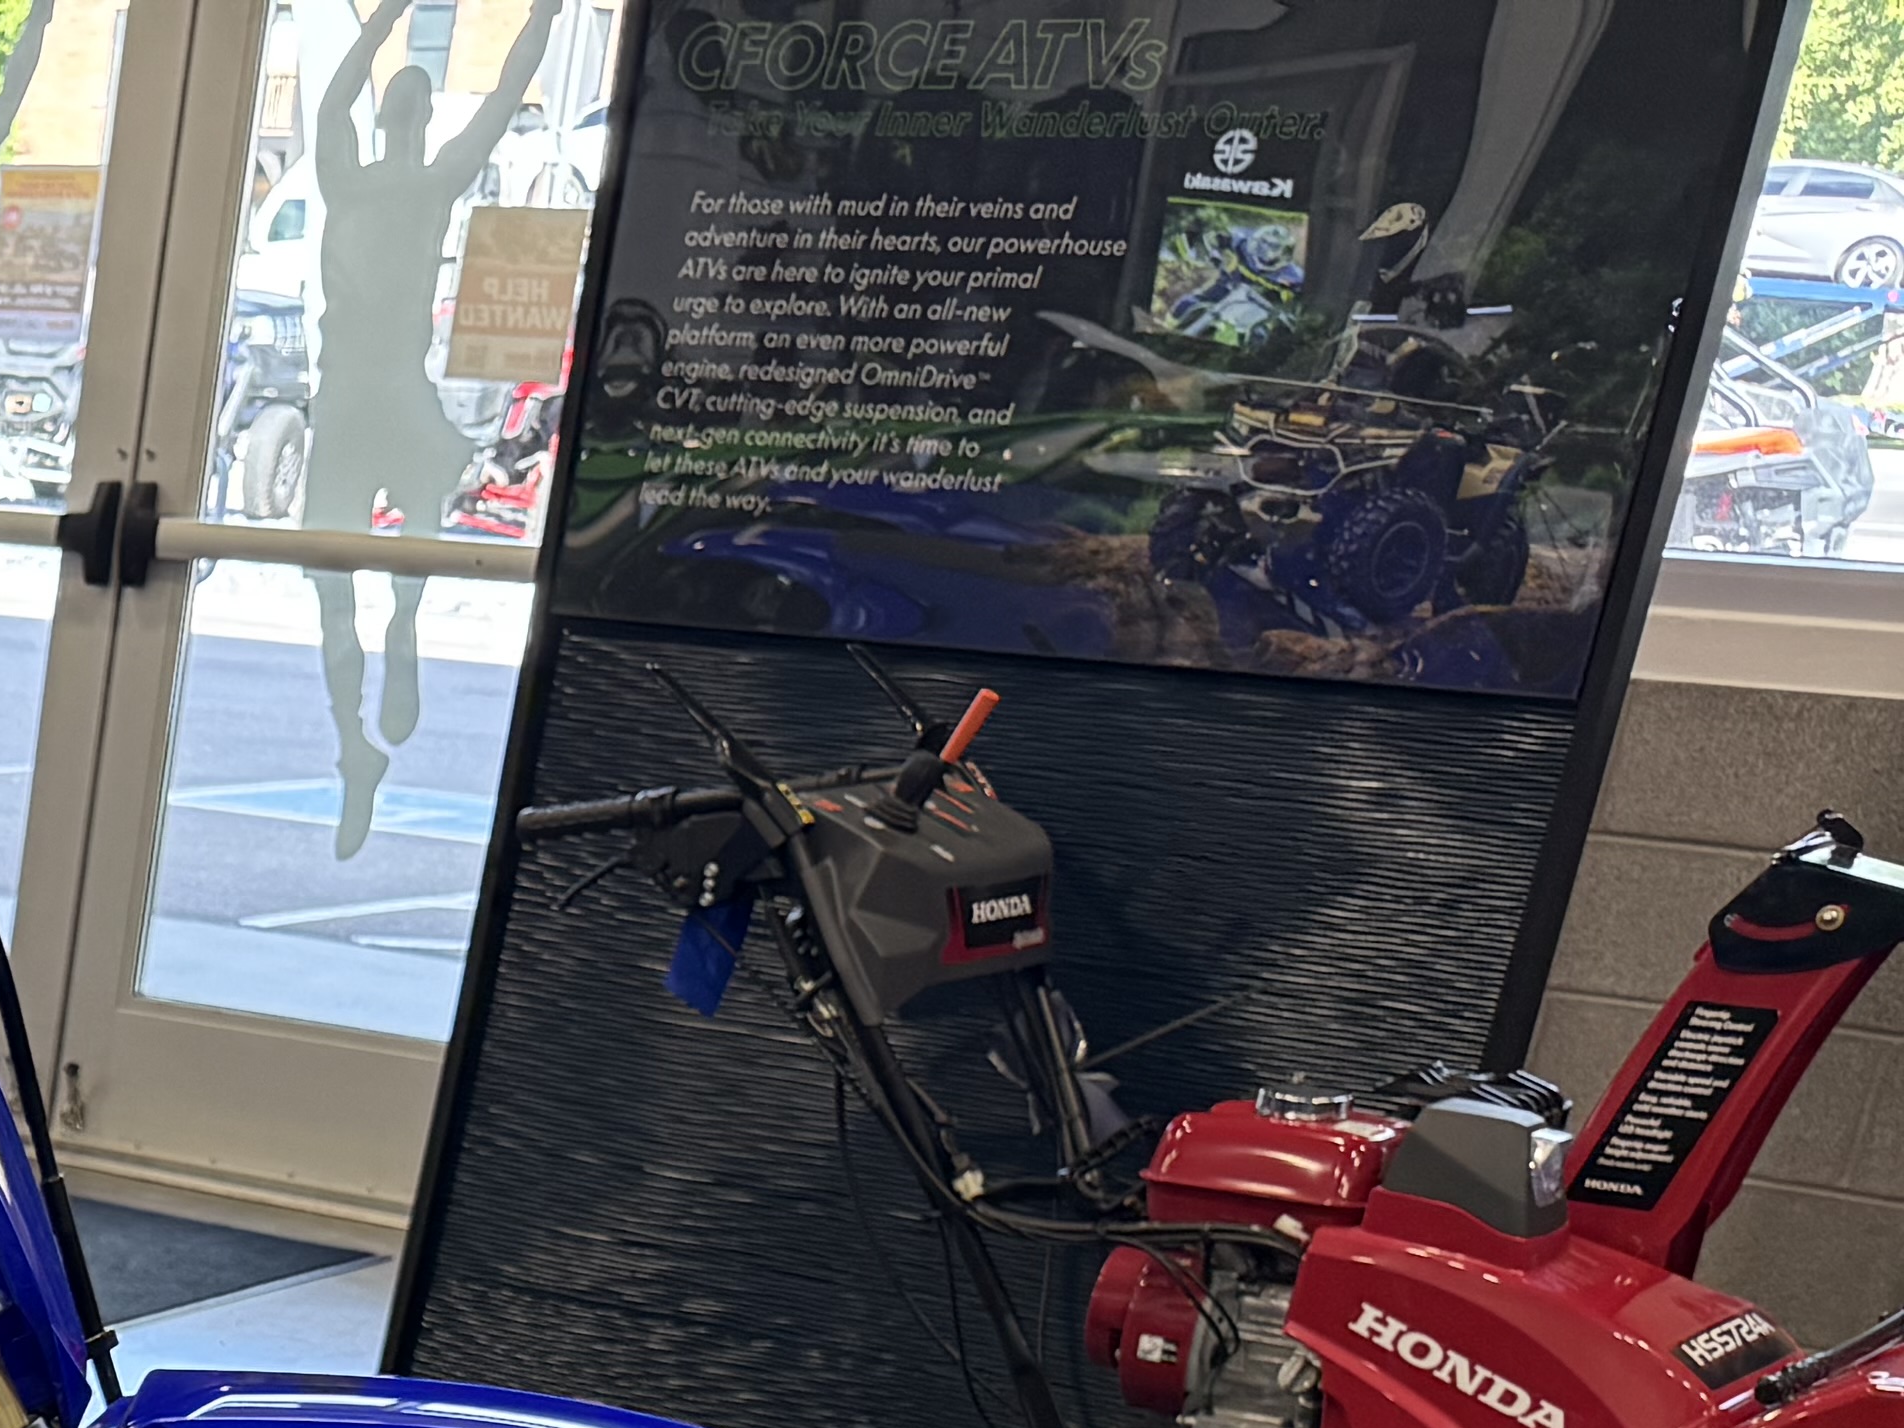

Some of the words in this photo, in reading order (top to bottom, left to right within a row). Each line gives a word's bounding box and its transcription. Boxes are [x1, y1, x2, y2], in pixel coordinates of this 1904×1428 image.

[678, 19, 974, 91] CFORCE
[970, 18, 1169, 90] ATVs
[707, 101, 783, 138] Take
[875, 102, 969, 139] Inner
[982, 102, 1192, 139] Wanderlust
[690, 191, 725, 213] For
[728, 194, 783, 216] those
[789, 193, 833, 217] with
[837, 195, 886, 218] mud
[889, 195, 909, 217] in
[915, 196, 966, 220] their
[969, 198, 1024, 220] veins
[1029, 196, 1077, 221] and
[684, 226, 788, 249] adventure
[793, 228, 812, 248] in
[817, 230, 870, 251] their
[870, 230, 942, 254] hearts,
[947, 236, 986, 254] our
[986, 236, 1128, 259] powerhouse
[677, 262, 727, 281] ATVs
[732, 265, 770, 282] are
[770, 263, 817, 284] here
[824, 266, 846, 284] to
[848, 265, 910, 290] ignite
[913, 271, 965, 292] your
[967, 265, 1044, 293] primal
[672, 295, 719, 319] urge
[723, 295, 746, 314] to
[748, 295, 832, 322] explore.
[839, 295, 888, 318] With
[893, 300, 921, 320] an
[926, 298, 1012, 323] all-new
[763, 331, 792, 349] an
[795, 333, 846, 351] even
[851, 335, 904, 353] more
[908, 332, 1010, 358] powerful
[738, 358, 858, 388] redesigned
[705, 391, 839, 424] cutting-edge
[968, 403, 1016, 426] and
[743, 427, 868, 457] connectivity
[906, 434, 953, 457] time
[958, 437, 980, 458] to
[673, 453, 728, 479] these
[784, 457, 828, 483] and
[828, 465, 877, 489] your
[971, 894, 1032, 924] HONDA
[1584, 1178, 1644, 1196] HONDA
[1681, 1311, 1776, 1367] HSS724A
